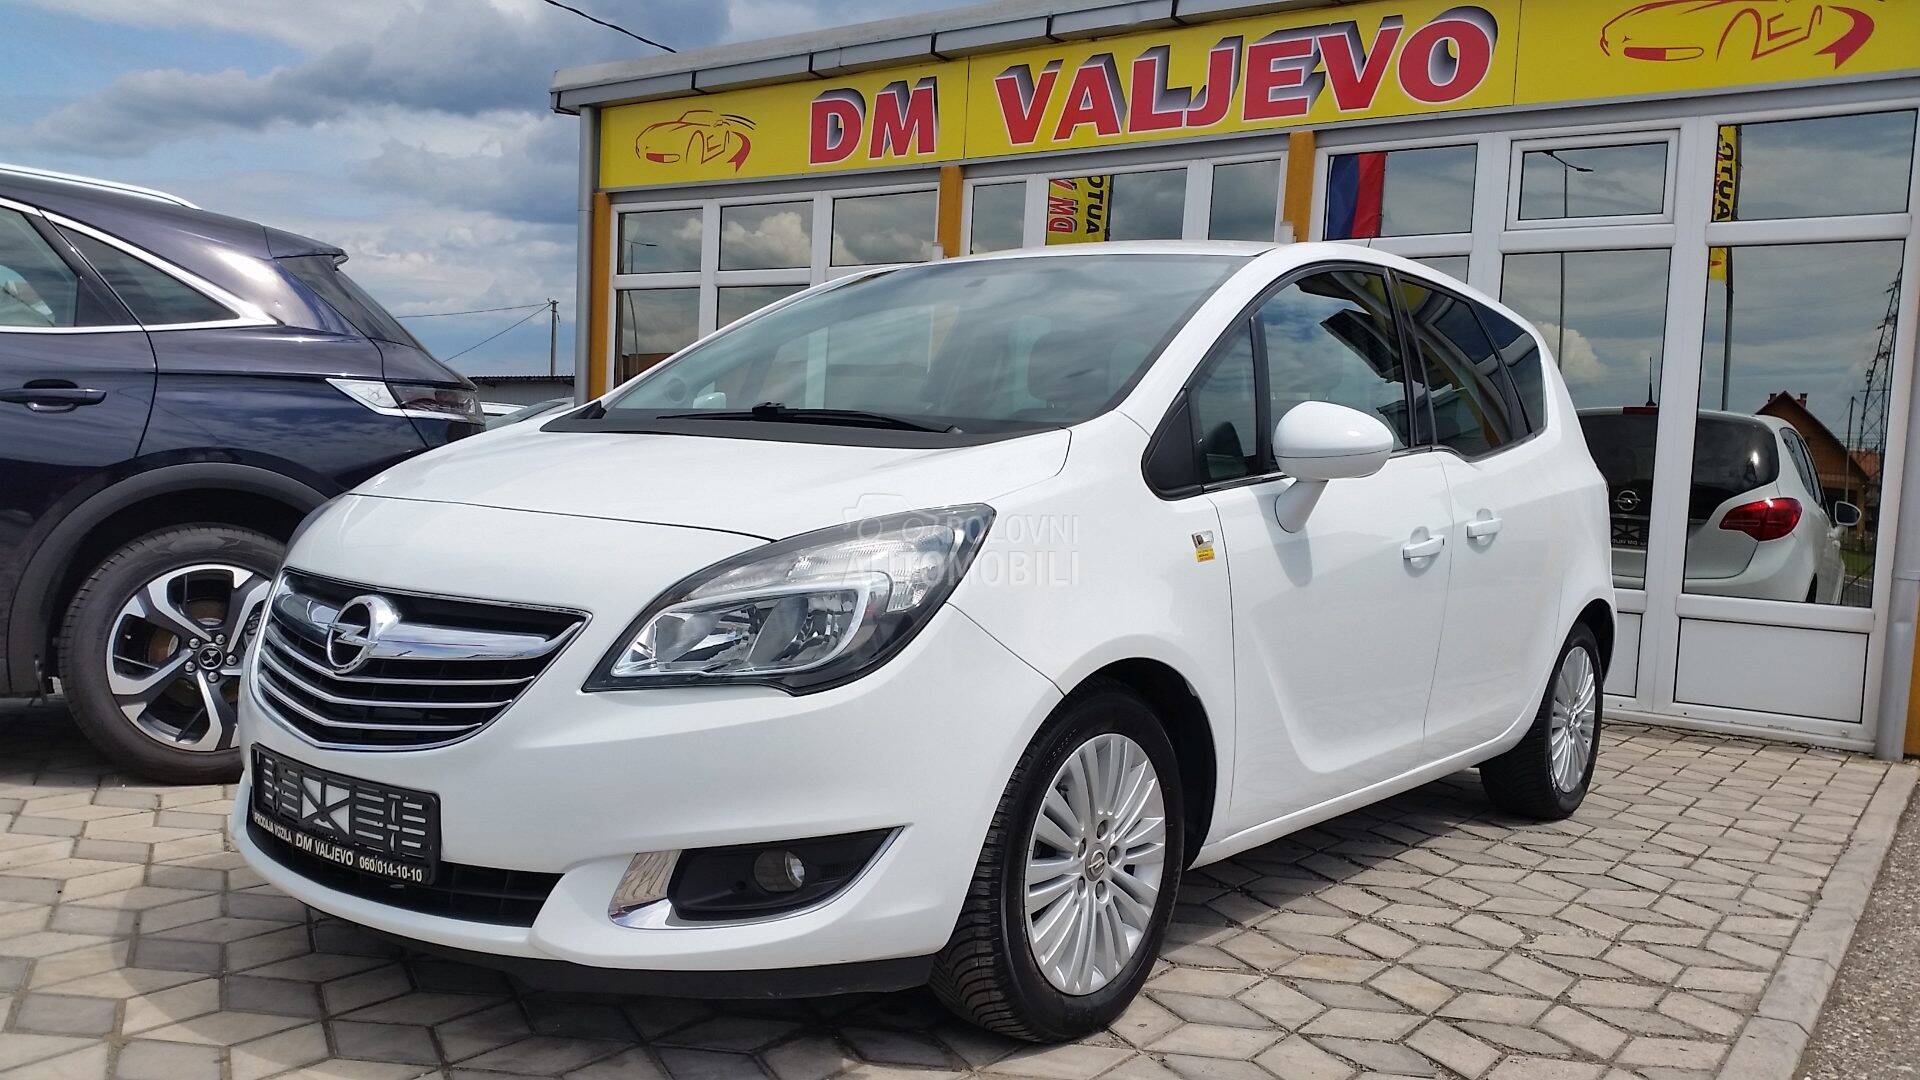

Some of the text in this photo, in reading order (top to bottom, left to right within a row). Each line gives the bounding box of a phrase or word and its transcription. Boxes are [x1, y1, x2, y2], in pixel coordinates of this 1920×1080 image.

[809, 7, 1497, 166] DM VALJEVO
[295, 832, 313, 852] DM
[314, 839, 354, 866] VALJEVO
[359, 856, 423, 882] 060/014-10-10
